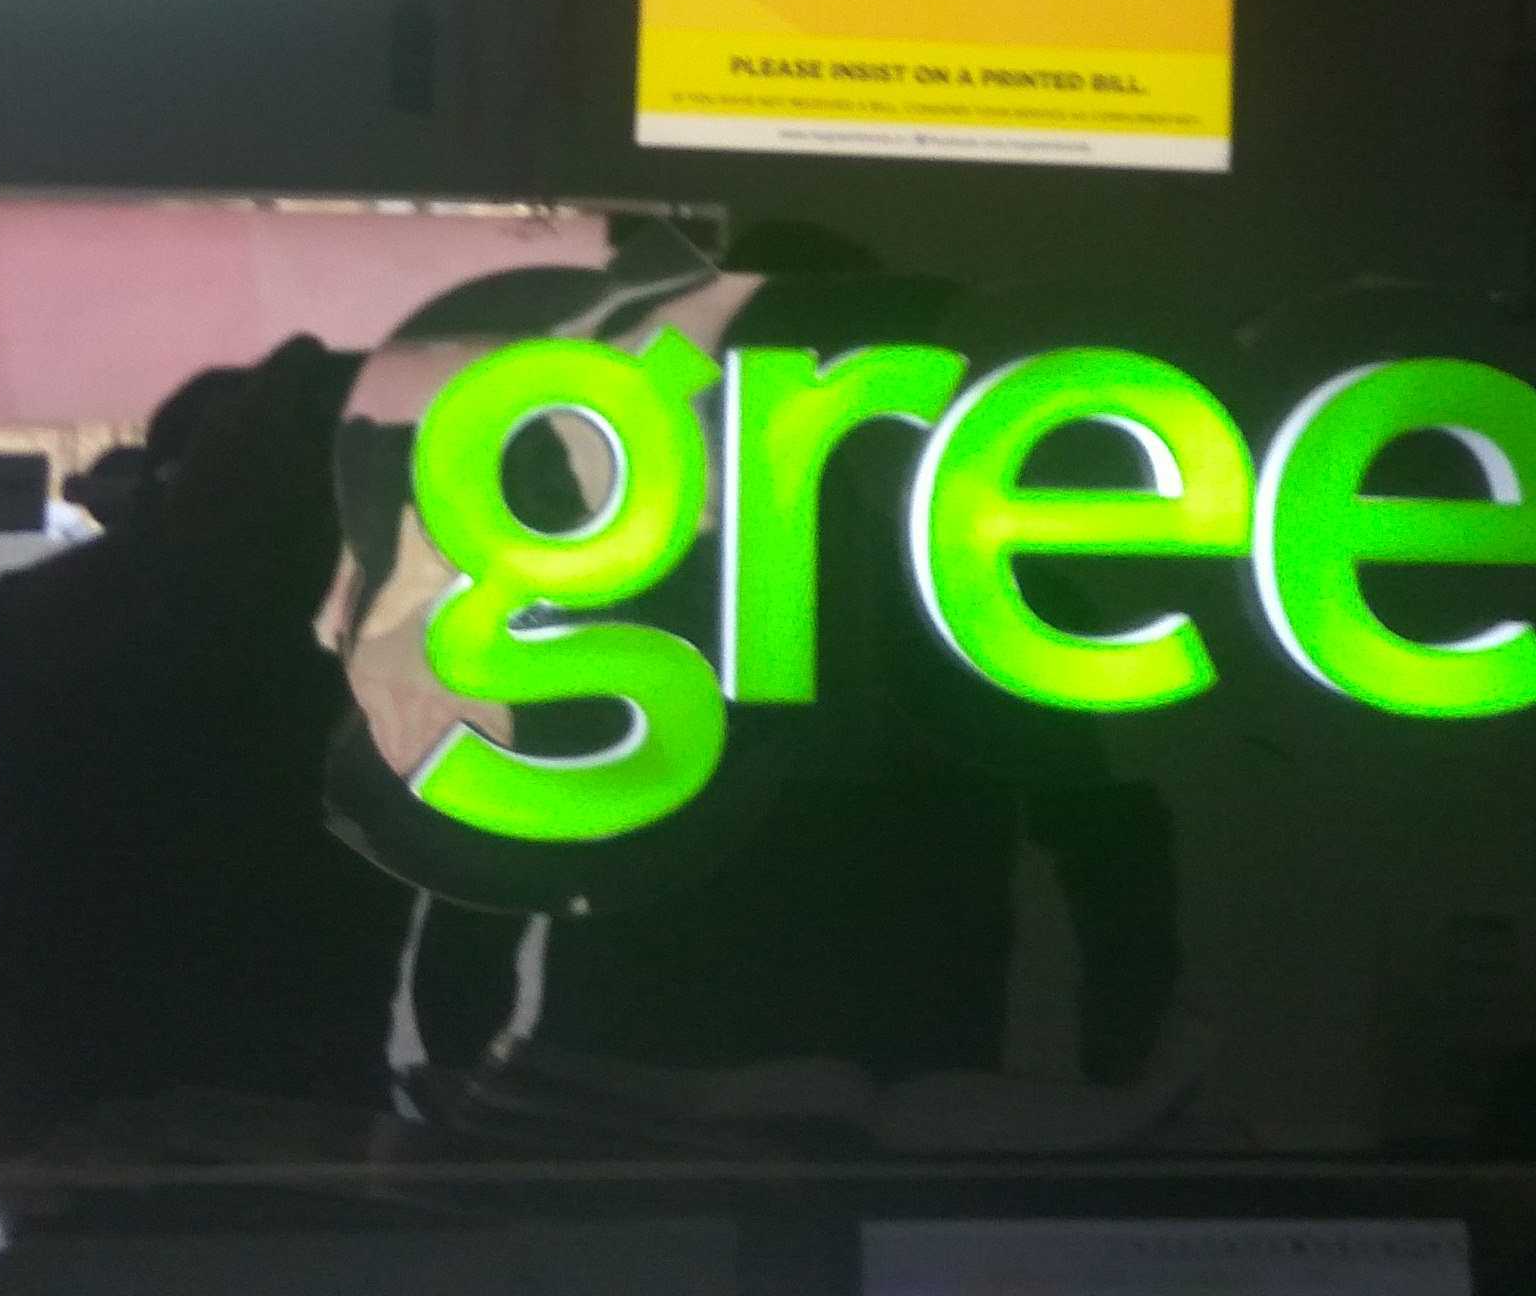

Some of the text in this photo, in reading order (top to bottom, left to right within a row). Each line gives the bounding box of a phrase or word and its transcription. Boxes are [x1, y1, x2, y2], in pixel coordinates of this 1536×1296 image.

[731, 56, 823, 79] PLEASE
[831, 61, 907, 82] INSIST
[915, 66, 948, 83] ON
[957, 68, 974, 84] A
[982, 69, 1083, 91] PRINTED
